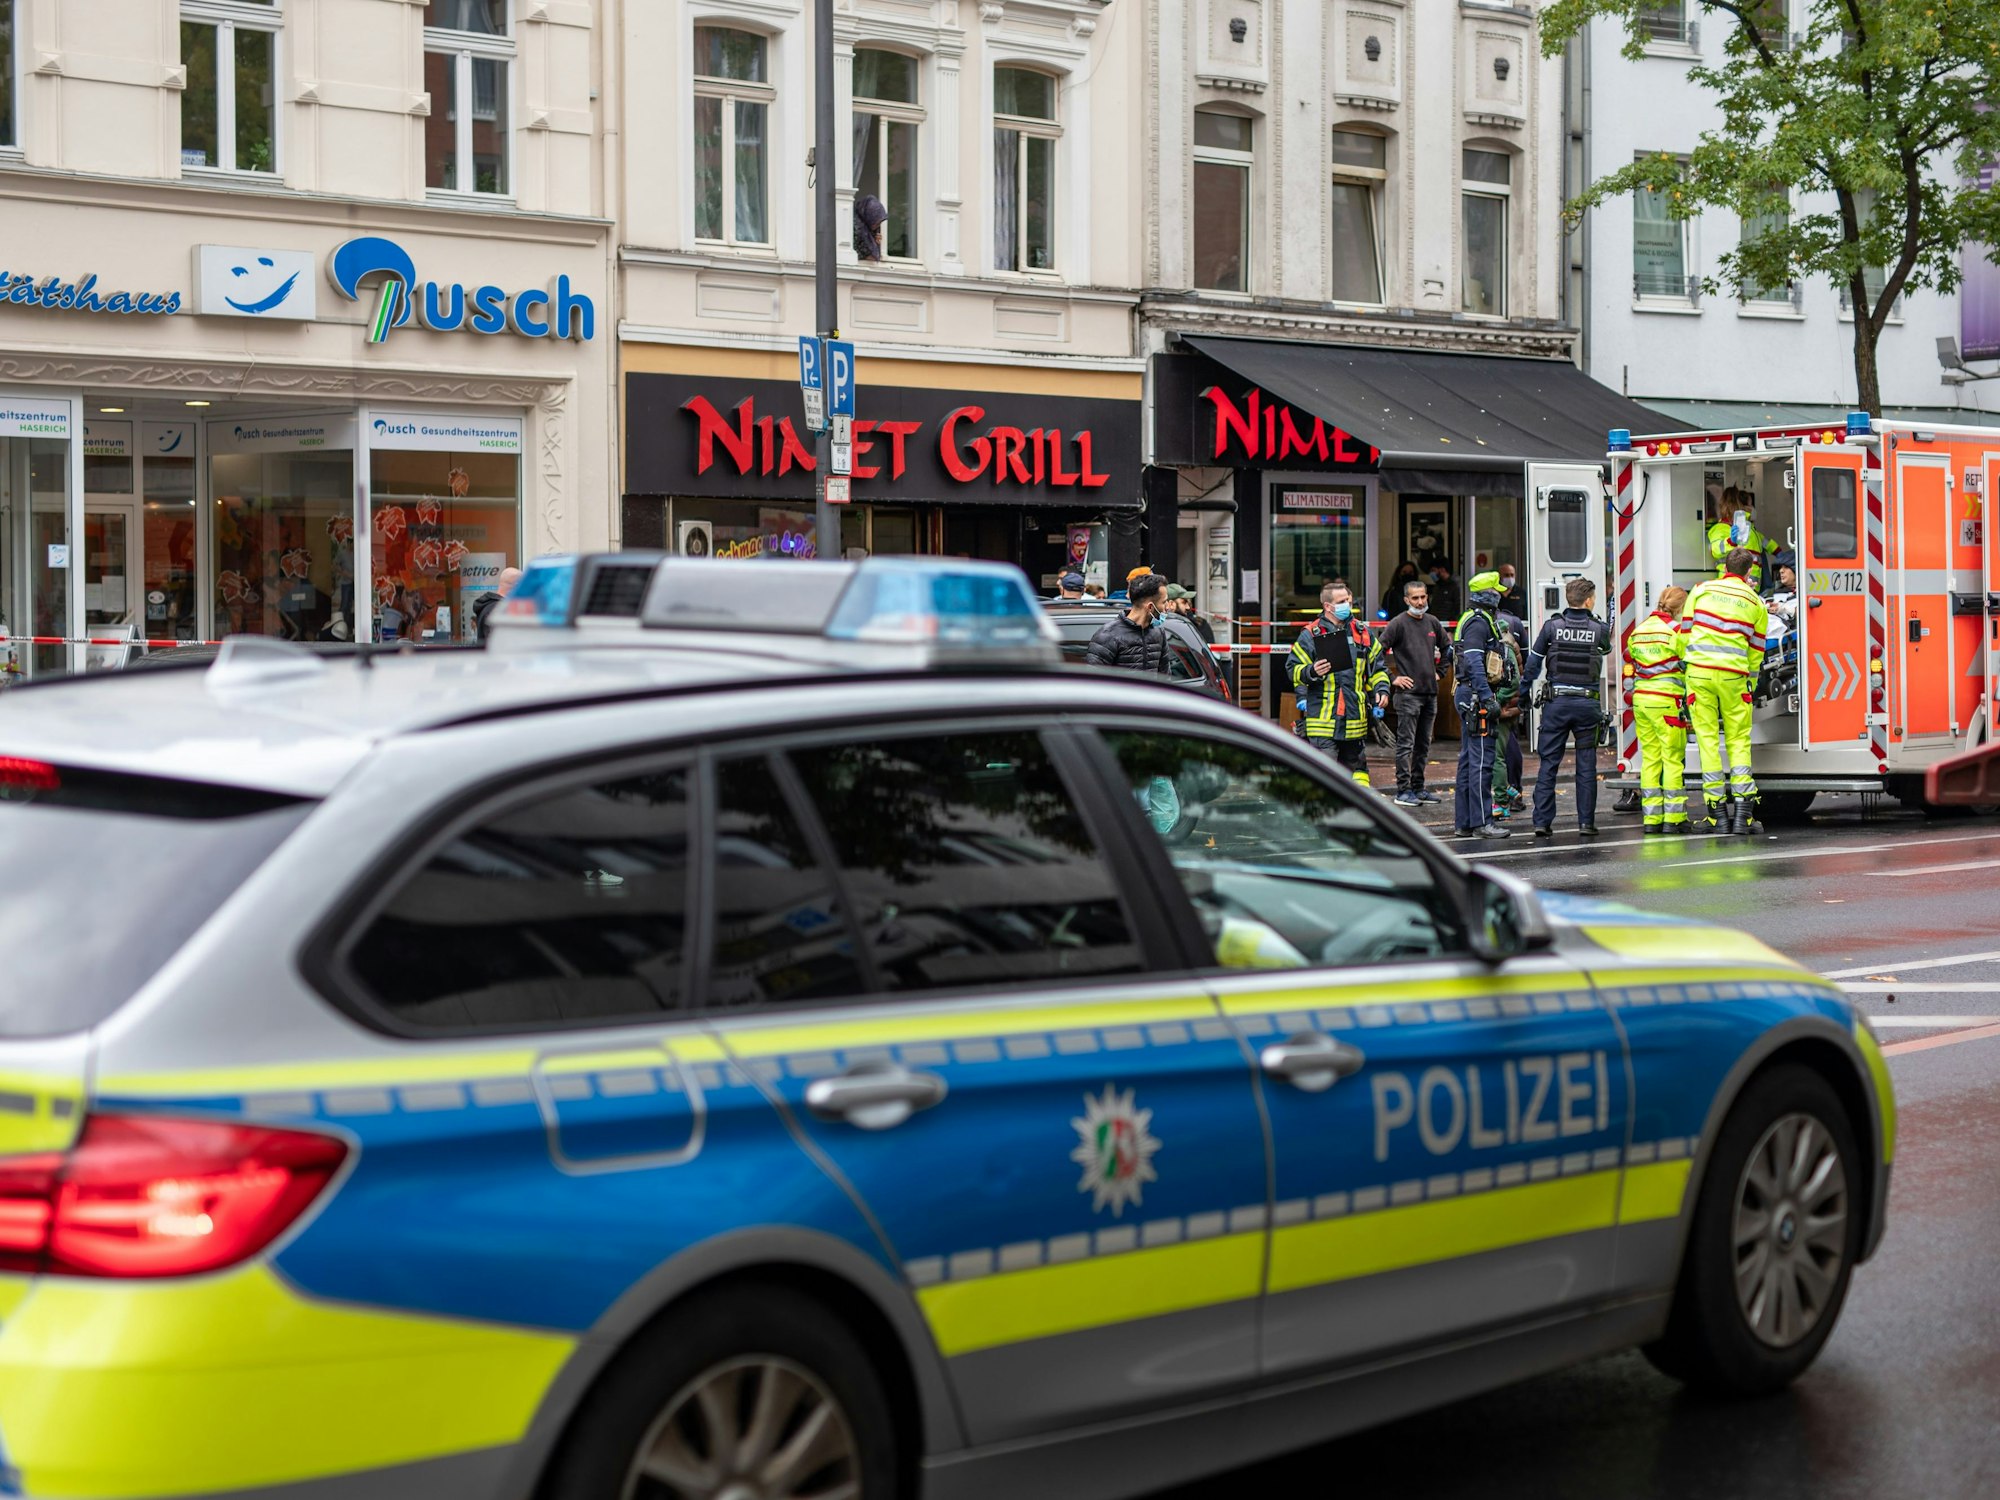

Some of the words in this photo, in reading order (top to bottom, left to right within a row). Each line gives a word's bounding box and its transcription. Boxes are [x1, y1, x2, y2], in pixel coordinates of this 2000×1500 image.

[333, 236, 595, 343] Busch
[802, 343, 815, 385] P
[833, 350, 849, 408] P
[19, 424, 67, 433] HASERICH
[262, 428, 324, 438] Gesundheitszentrum
[421, 426, 518, 438] Gesundheitszentrum
[1199, 385, 1380, 464] NIME
[479, 440, 518, 448] HASERICH
[938, 405, 1111, 487] GRILL
[1284, 494, 1352, 508] KLIMATISIERT
[462, 565, 499, 577] active
[1845, 572, 1863, 592] 112
[1556, 628, 1595, 643] POLIZEI
[1369, 1050, 1609, 1163] POLIZEI
